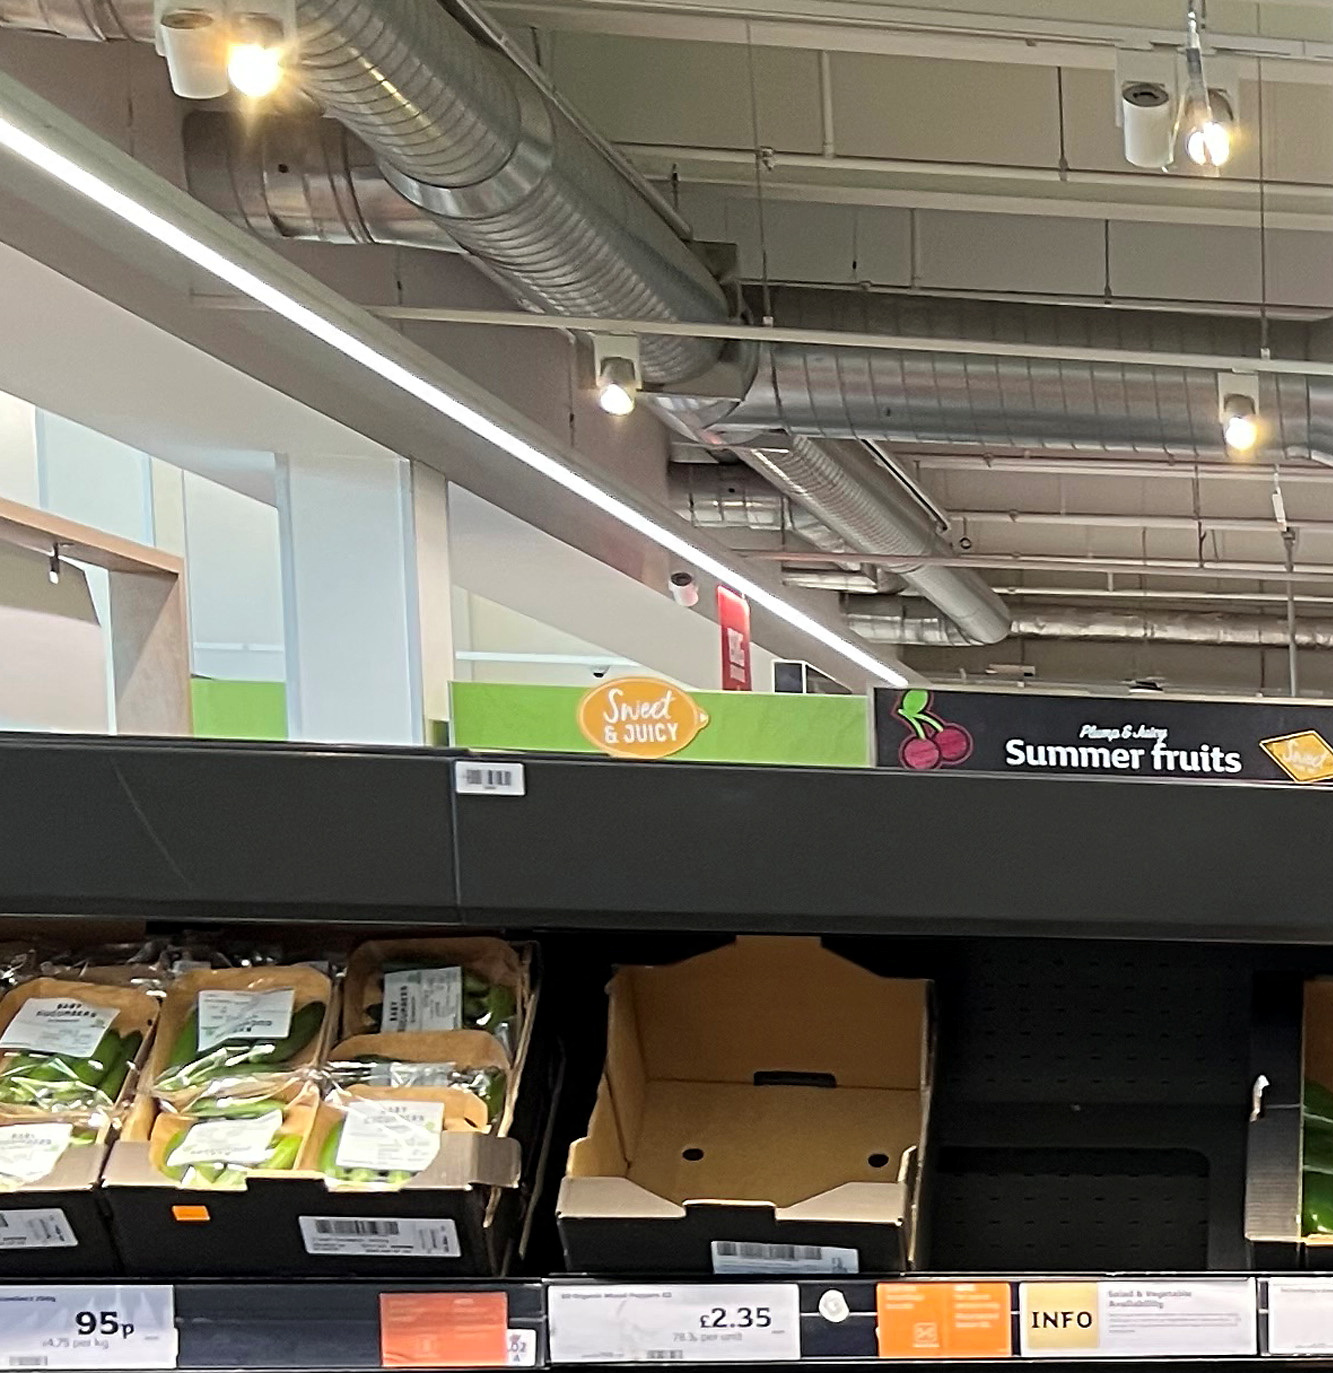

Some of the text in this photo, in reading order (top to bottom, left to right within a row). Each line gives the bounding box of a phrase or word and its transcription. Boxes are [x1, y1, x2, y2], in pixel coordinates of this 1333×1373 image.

[603, 687, 677, 725] Sweet
[604, 723, 678, 744] & JUICY
[1121, 724, 1133, 739] &
[1005, 739, 1242, 773] Summer fruits
[75, 1311, 135, 1339] 95p
[700, 1307, 772, 1329] £2.35
[1031, 1311, 1093, 1328] INFO
